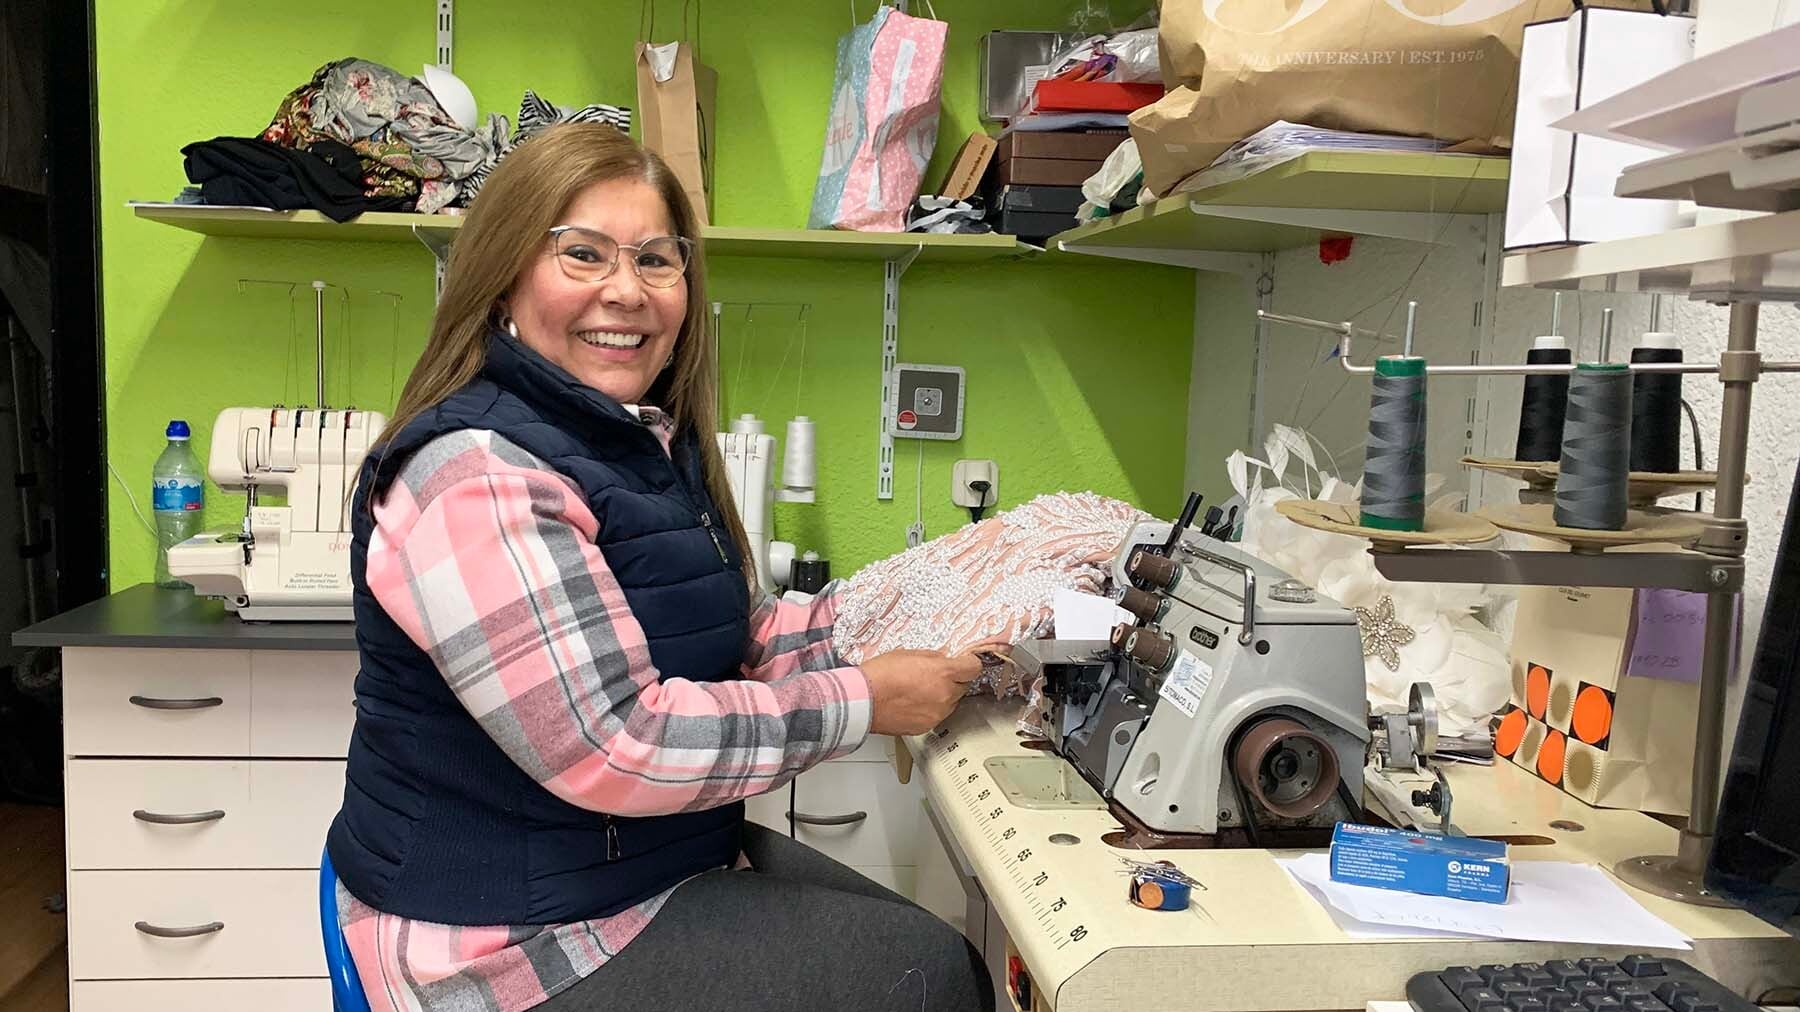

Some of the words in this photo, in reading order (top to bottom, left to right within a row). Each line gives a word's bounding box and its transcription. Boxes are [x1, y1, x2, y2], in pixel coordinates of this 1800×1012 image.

[1192, 629, 1215, 647] brother
[990, 807, 1003, 820] 55
[1003, 827, 1017, 840] 60
[1017, 848, 1033, 862] 65
[1463, 863, 1490, 872] KERN
[1033, 871, 1049, 887] 70
[1051, 897, 1068, 912] 75
[1070, 925, 1088, 942] 80
